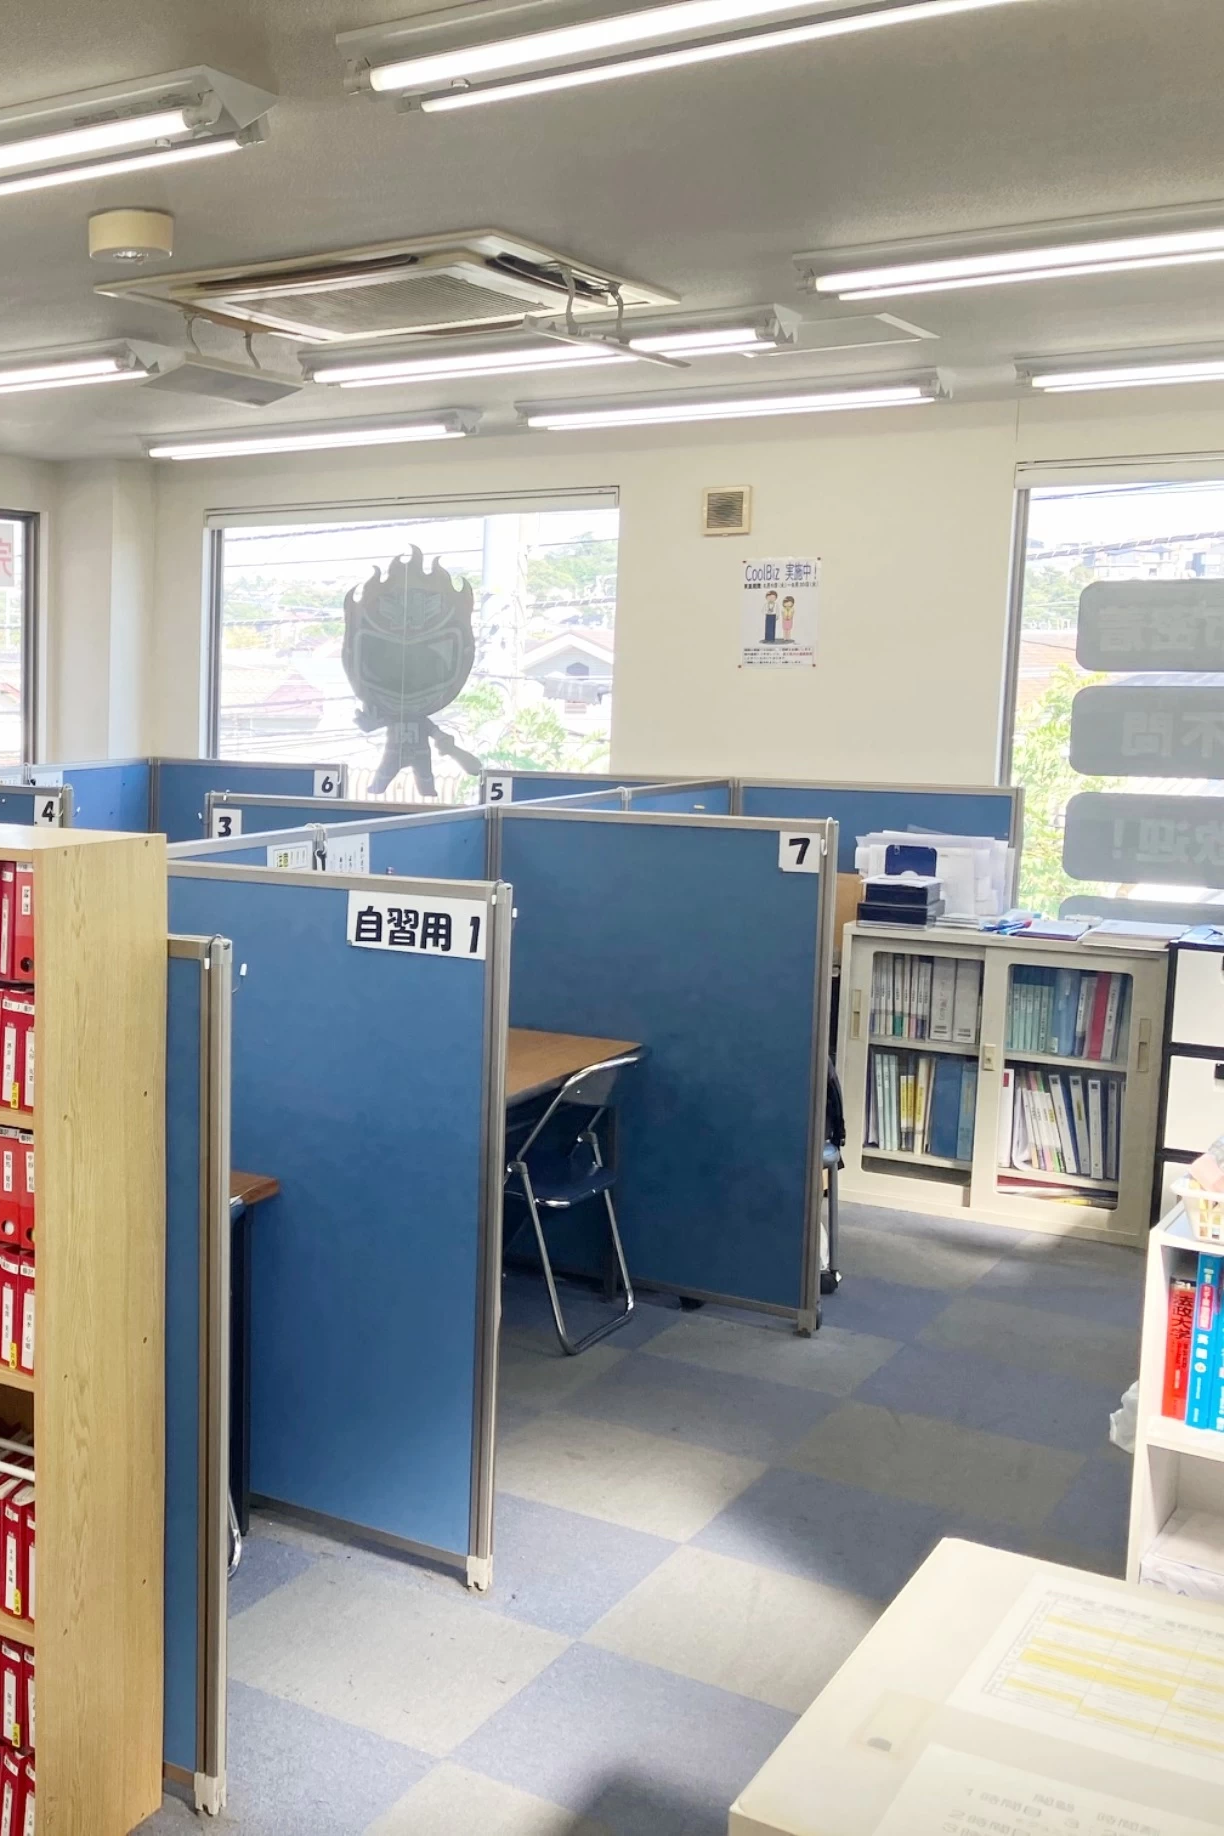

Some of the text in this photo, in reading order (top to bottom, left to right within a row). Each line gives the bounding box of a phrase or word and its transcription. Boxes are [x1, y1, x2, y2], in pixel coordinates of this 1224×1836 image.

[321, 775, 334, 793] 6
[490, 782, 504, 801] 5
[41, 800, 55, 822] 4
[218, 816, 232, 838] 3
[788, 837, 811, 865] 7
[355, 905, 481, 953] 自習用 1
